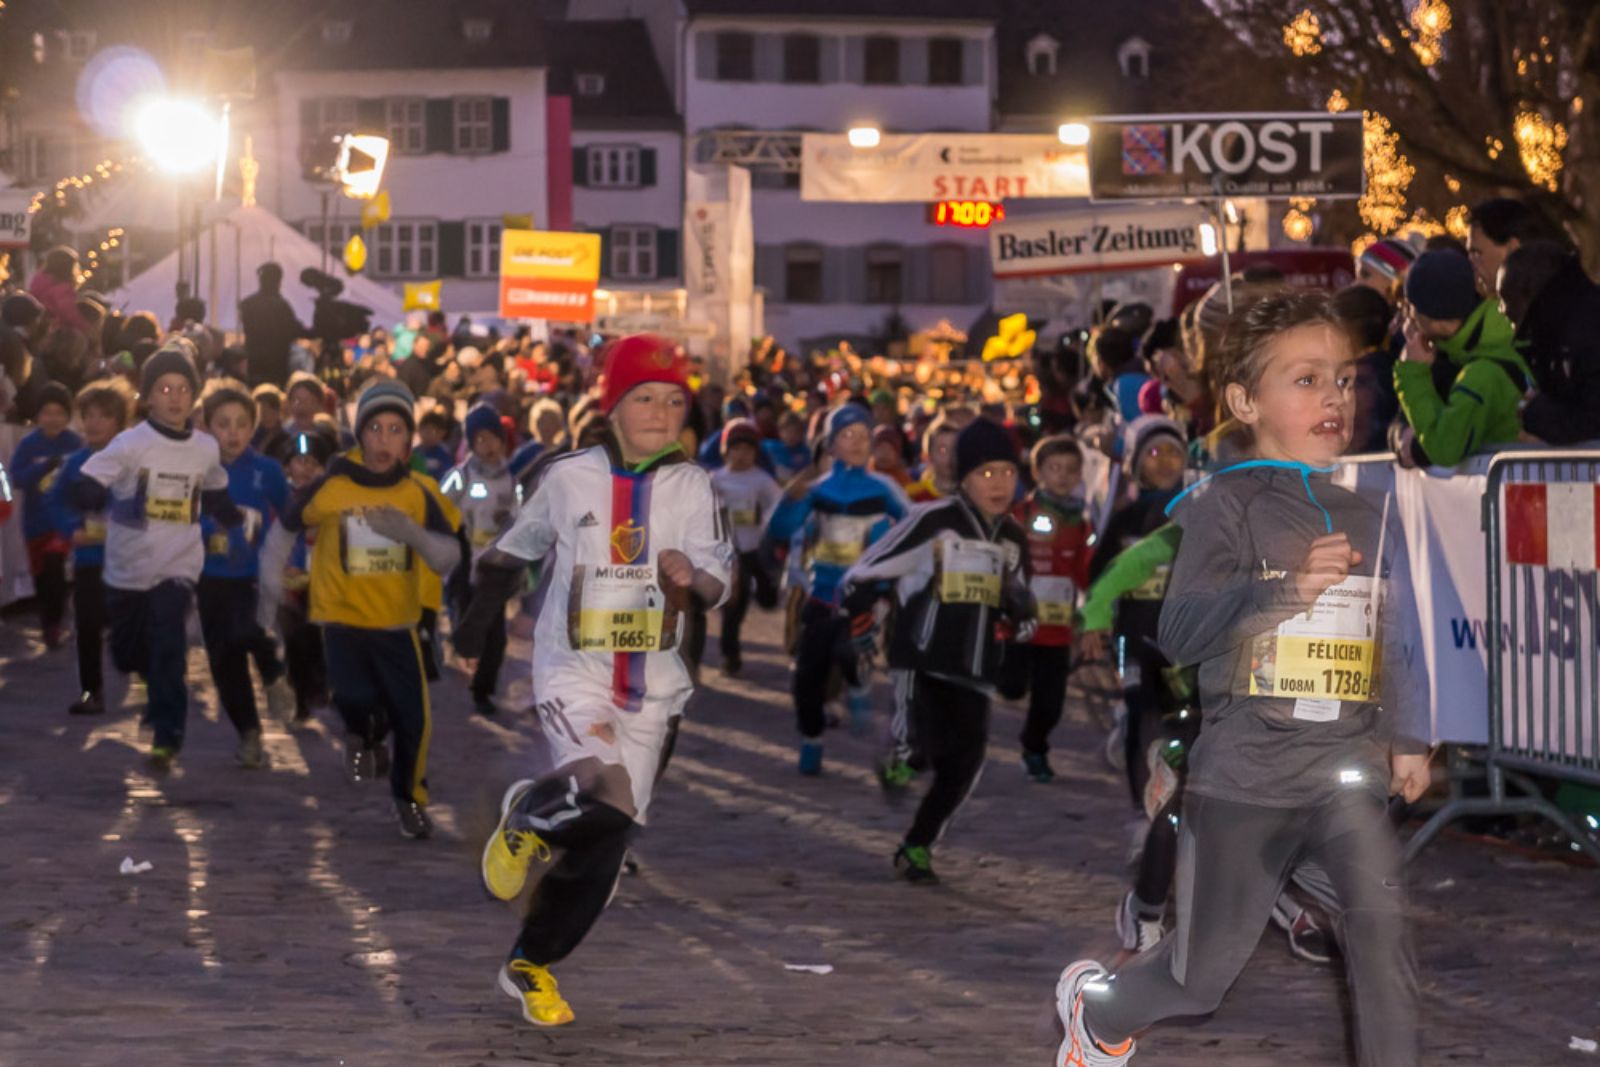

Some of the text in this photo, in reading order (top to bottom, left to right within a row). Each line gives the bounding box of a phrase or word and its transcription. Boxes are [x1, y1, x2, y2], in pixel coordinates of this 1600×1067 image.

[1172, 121, 1333, 174] KOST
[933, 176, 1027, 198] START
[998, 225, 1198, 260] Basler Zeitung
[595, 568, 653, 579] MIGROS
[613, 613, 634, 624] BEN
[611, 631, 644, 647] 1665
[1307, 640, 1362, 661] FÉLICIEN
[1280, 669, 1362, 695] U08M 1738
